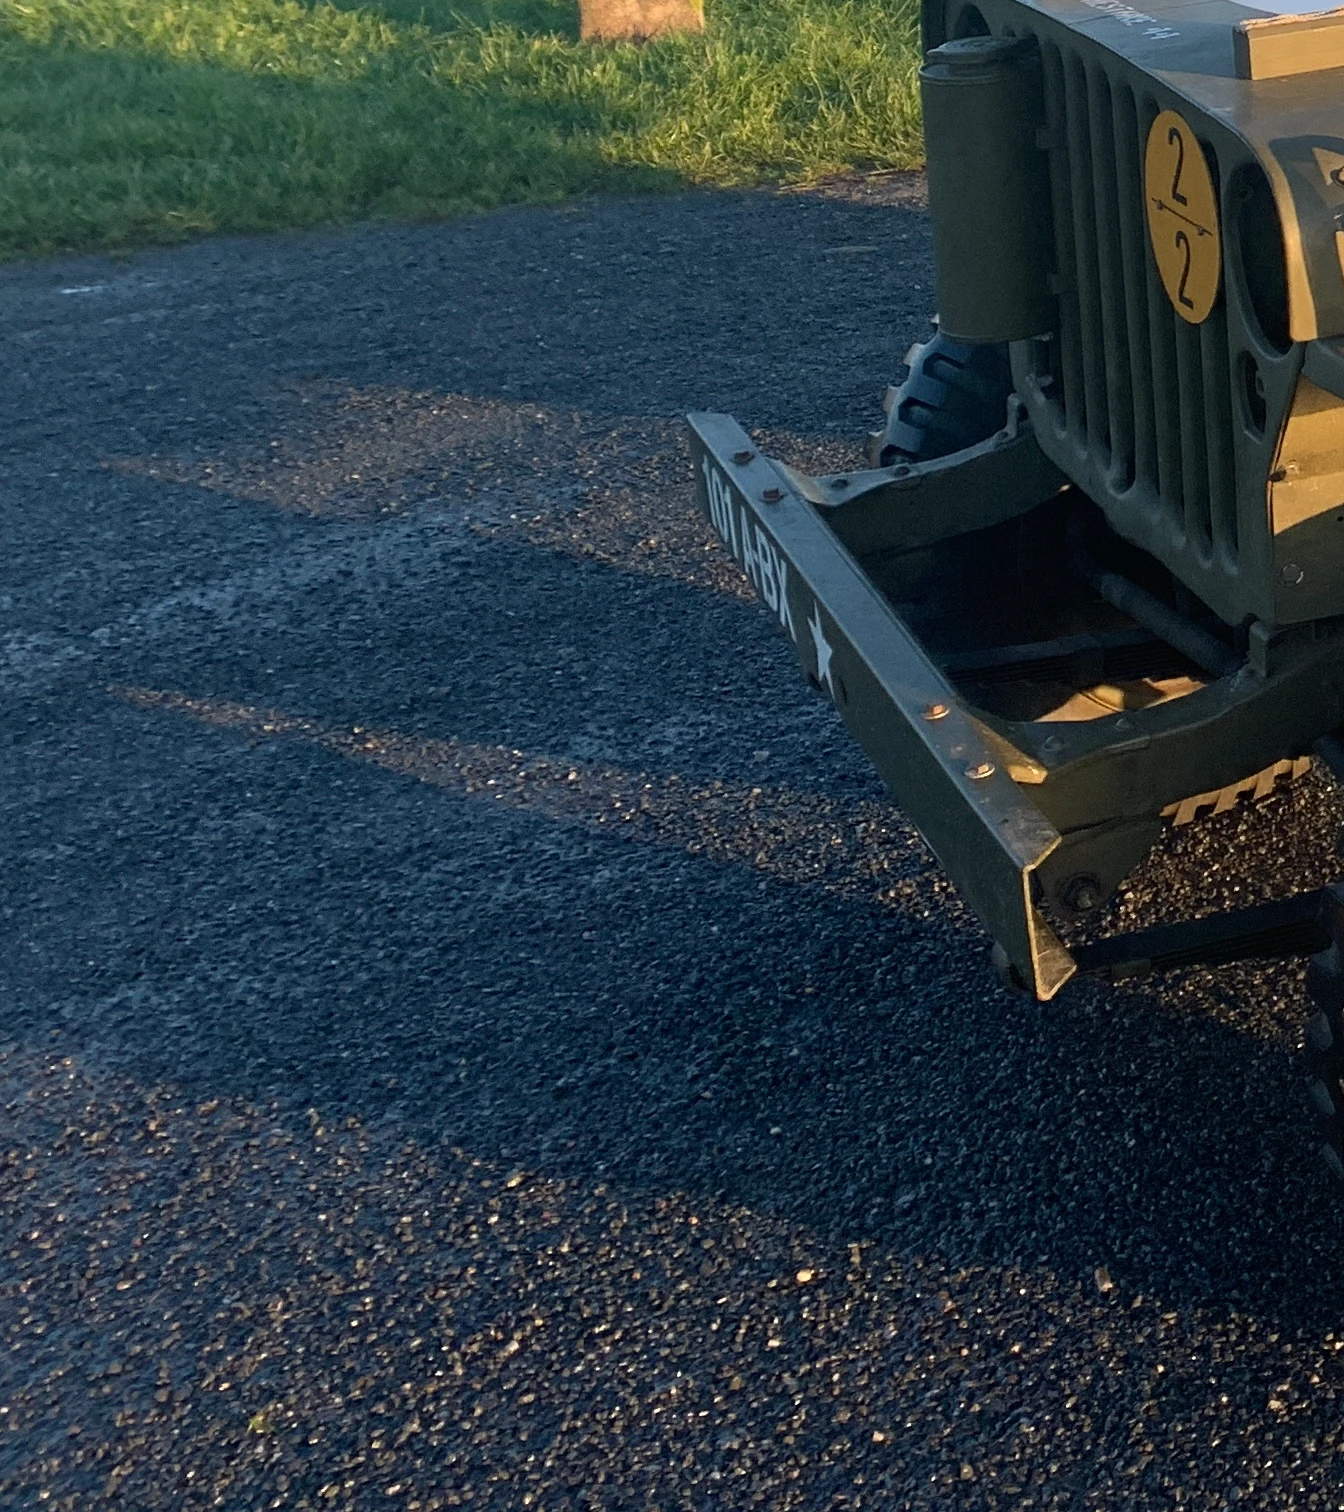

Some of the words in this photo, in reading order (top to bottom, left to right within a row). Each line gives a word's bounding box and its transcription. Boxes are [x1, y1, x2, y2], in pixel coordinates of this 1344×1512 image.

[1168, 126, 1188, 207] 2
[1175, 230, 1194, 310] 2
[702, 454, 739, 560] 101
